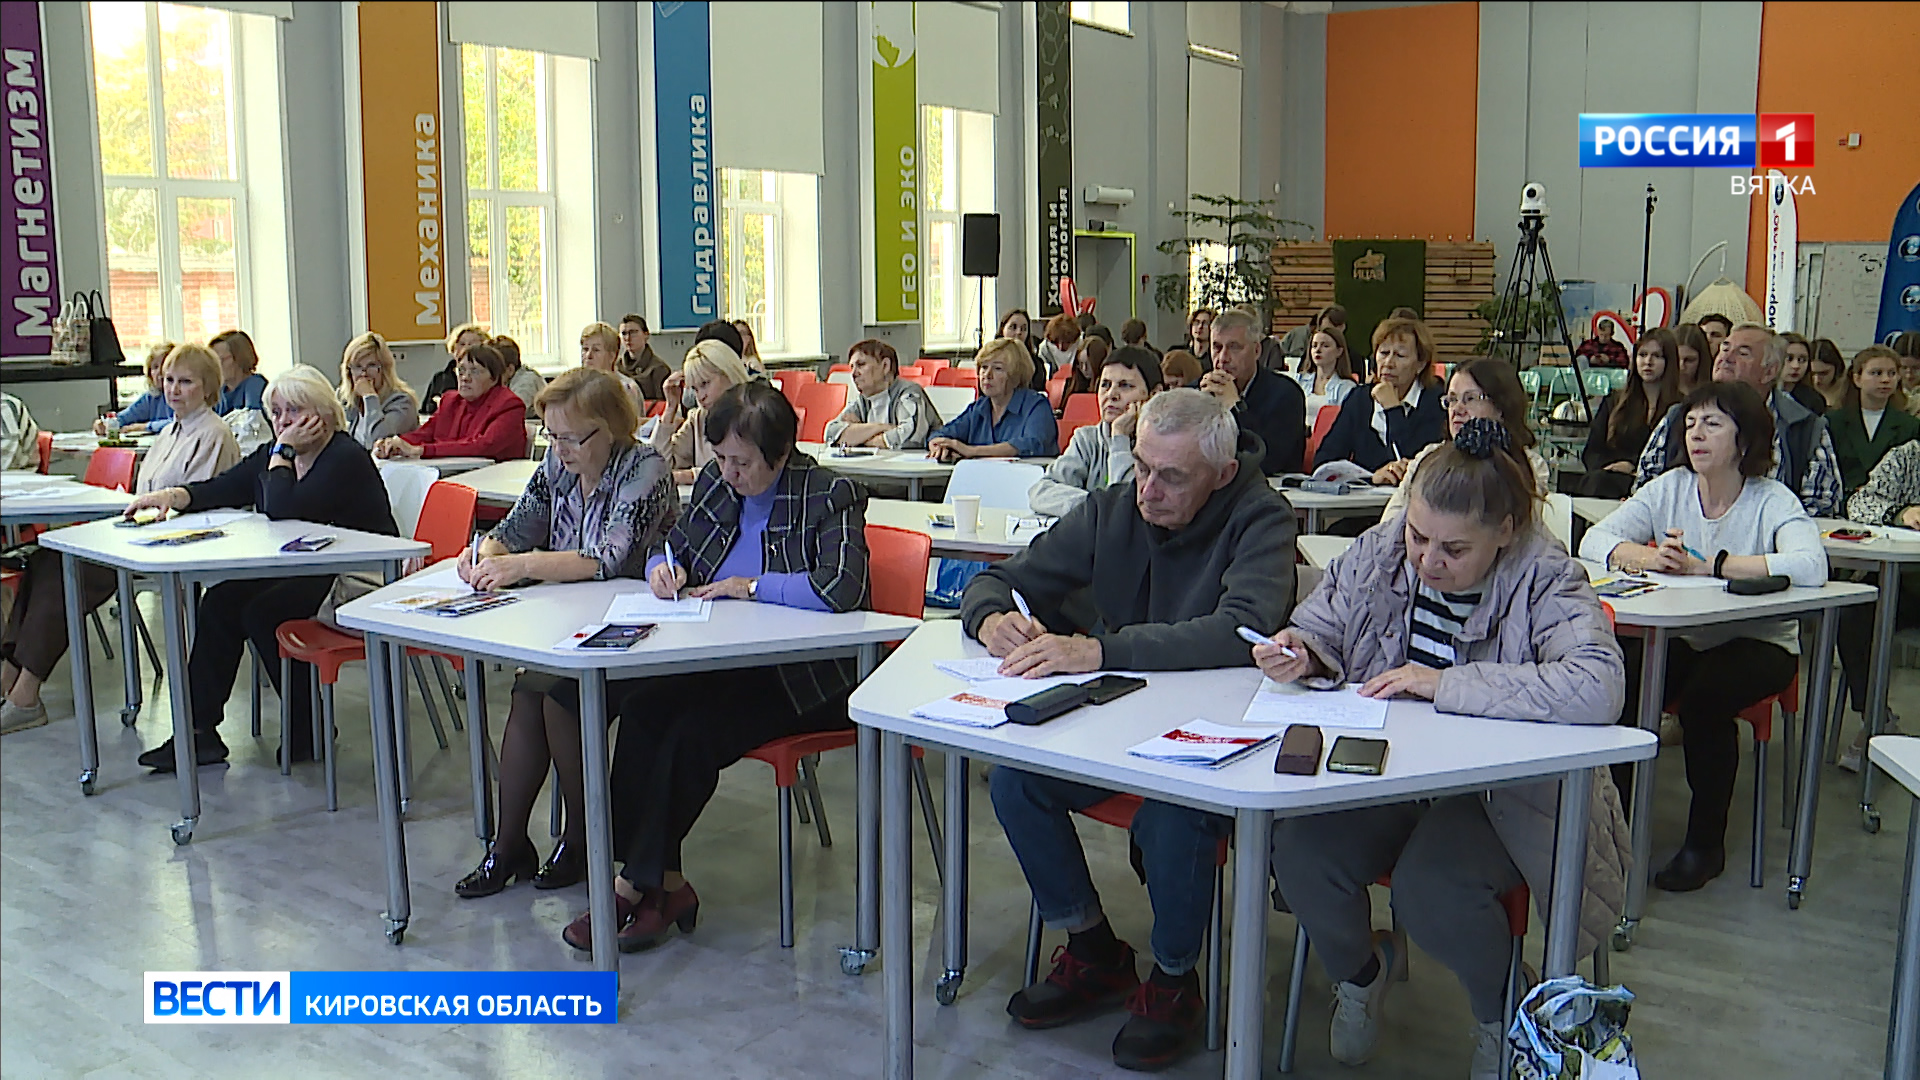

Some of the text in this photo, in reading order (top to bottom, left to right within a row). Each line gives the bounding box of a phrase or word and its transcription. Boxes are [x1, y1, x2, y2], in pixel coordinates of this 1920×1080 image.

[4, 48, 53, 338] Магнетизм
[415, 112, 441, 326] Механика
[690, 94, 715, 315] Гидравлика
[900, 145, 915, 210] ЭКО
[902, 252, 917, 311] ГЕО
[1048, 224, 1059, 306] Химия
[1059, 187, 1069, 305] ология
